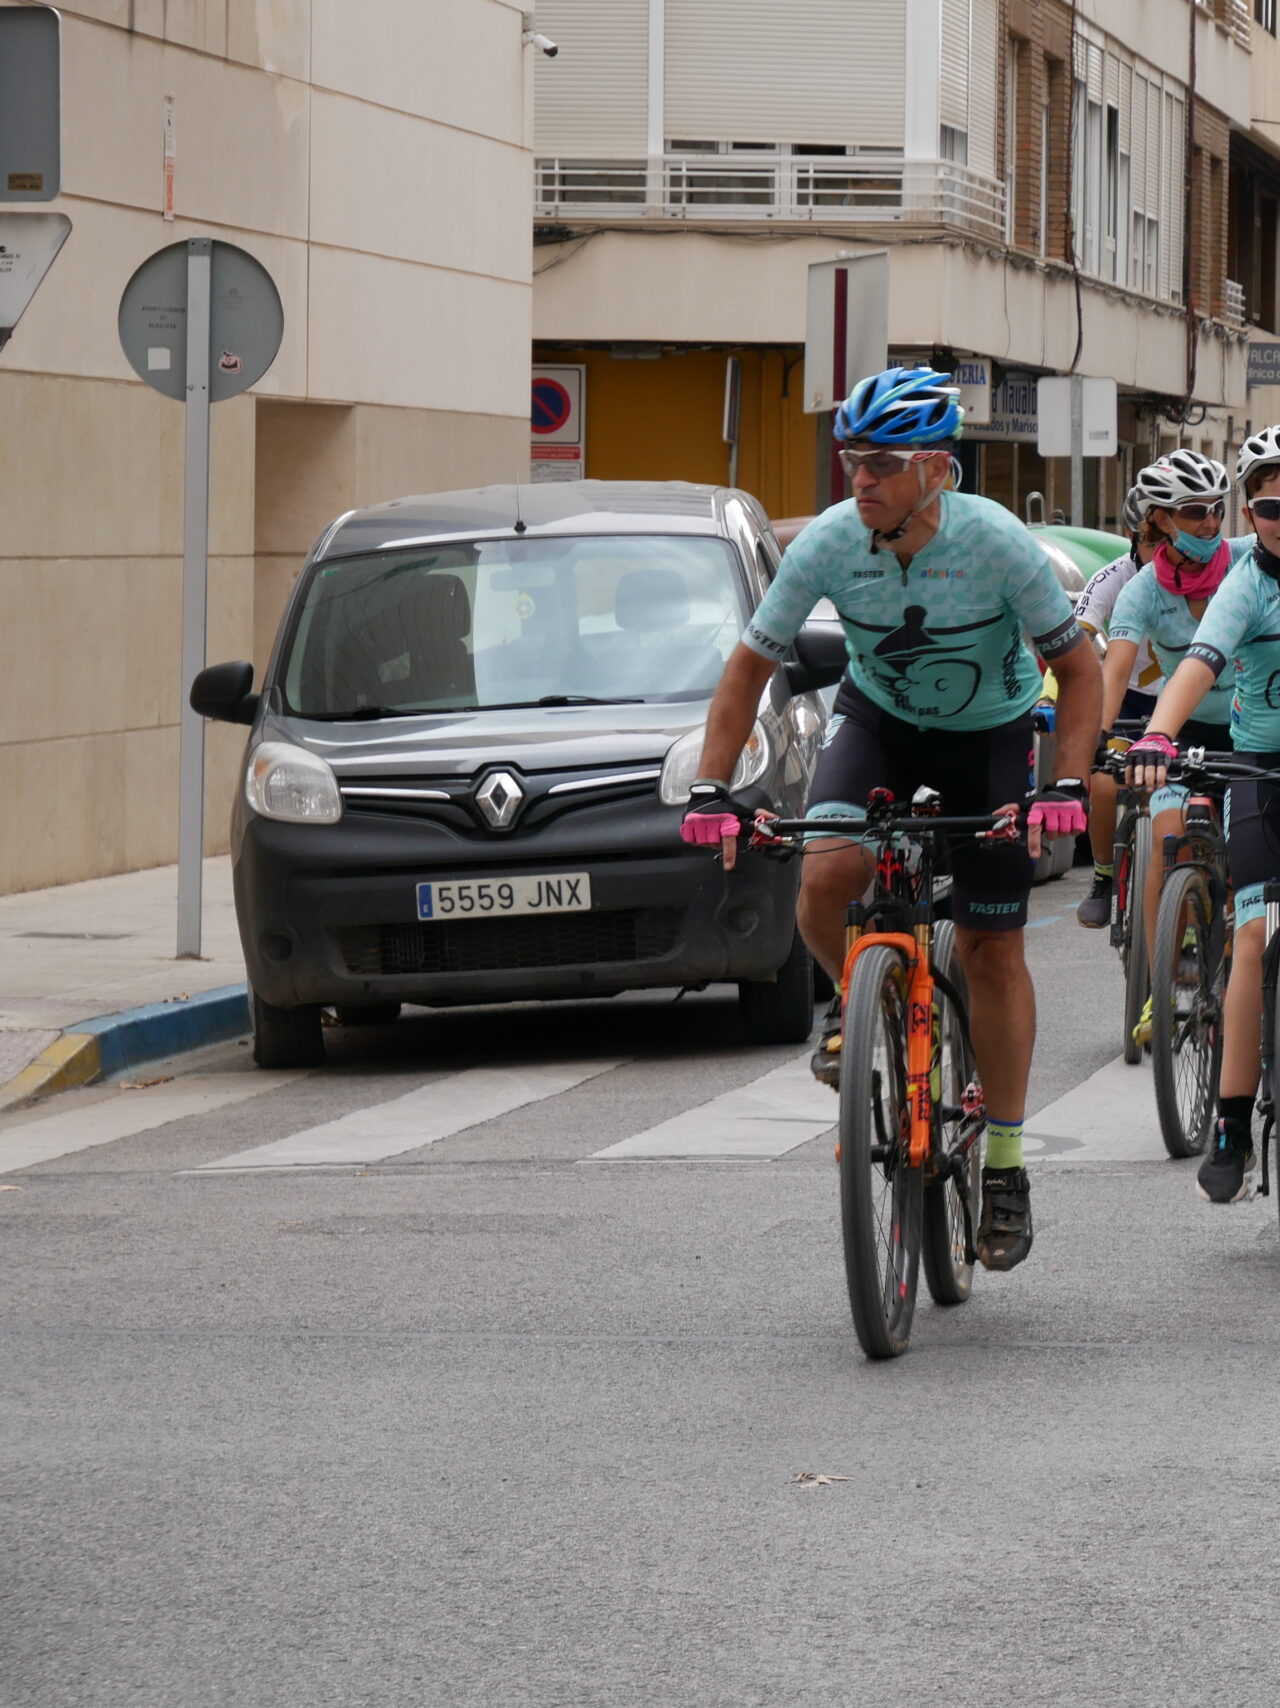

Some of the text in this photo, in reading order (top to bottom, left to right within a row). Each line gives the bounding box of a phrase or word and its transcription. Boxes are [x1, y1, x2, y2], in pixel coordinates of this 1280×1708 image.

[437, 878, 583, 913] 5559 JNX
[969, 902, 1020, 915] FASTER
